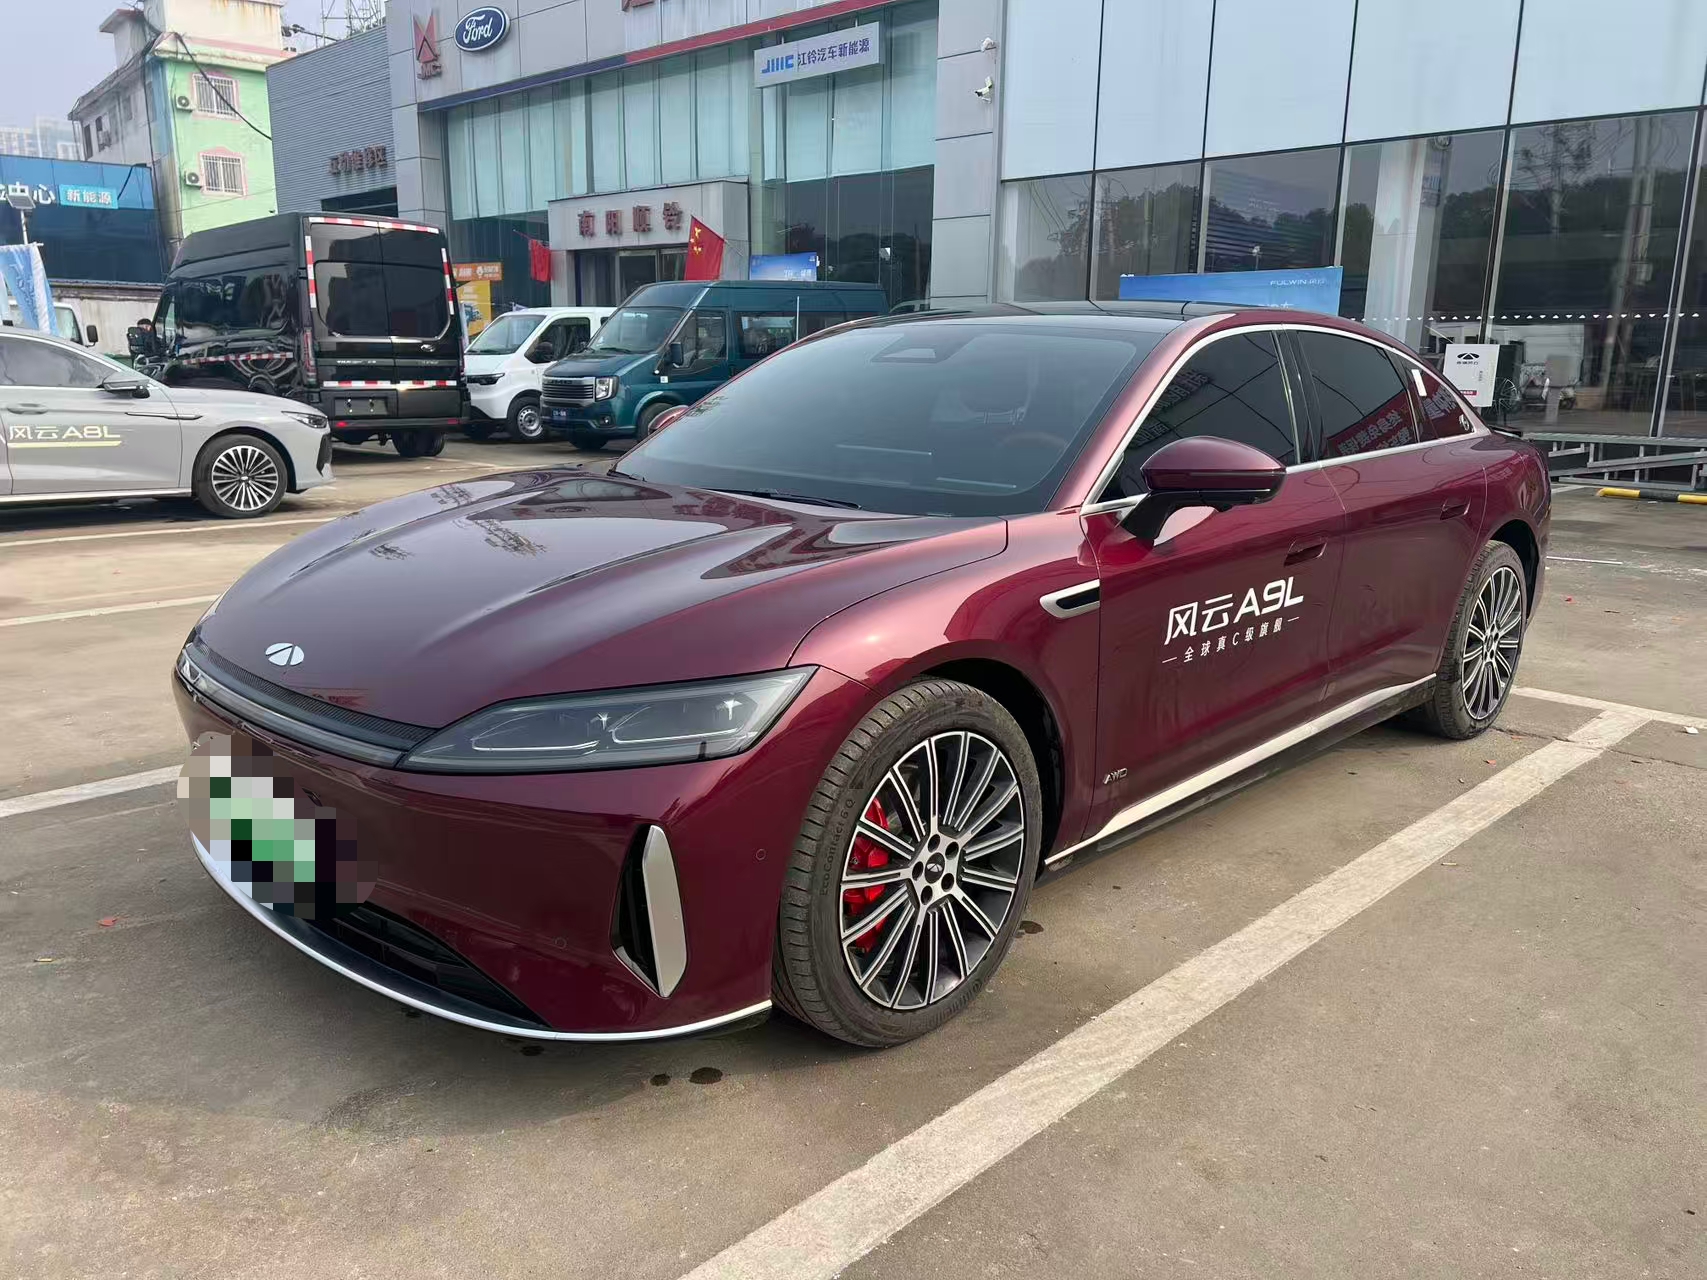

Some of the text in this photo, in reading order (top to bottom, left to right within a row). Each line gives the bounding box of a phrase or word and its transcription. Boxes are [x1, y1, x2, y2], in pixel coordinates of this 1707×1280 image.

[462, 14, 494, 44] Ford
[797, 37, 870, 66] 江铃汽车新能源
[67, 188, 111, 204] 新能源
[9, 425, 121, 440] 风云A8L
[1164, 576, 1304, 646] 风云A9L
[1103, 767, 1128, 785] AWD
